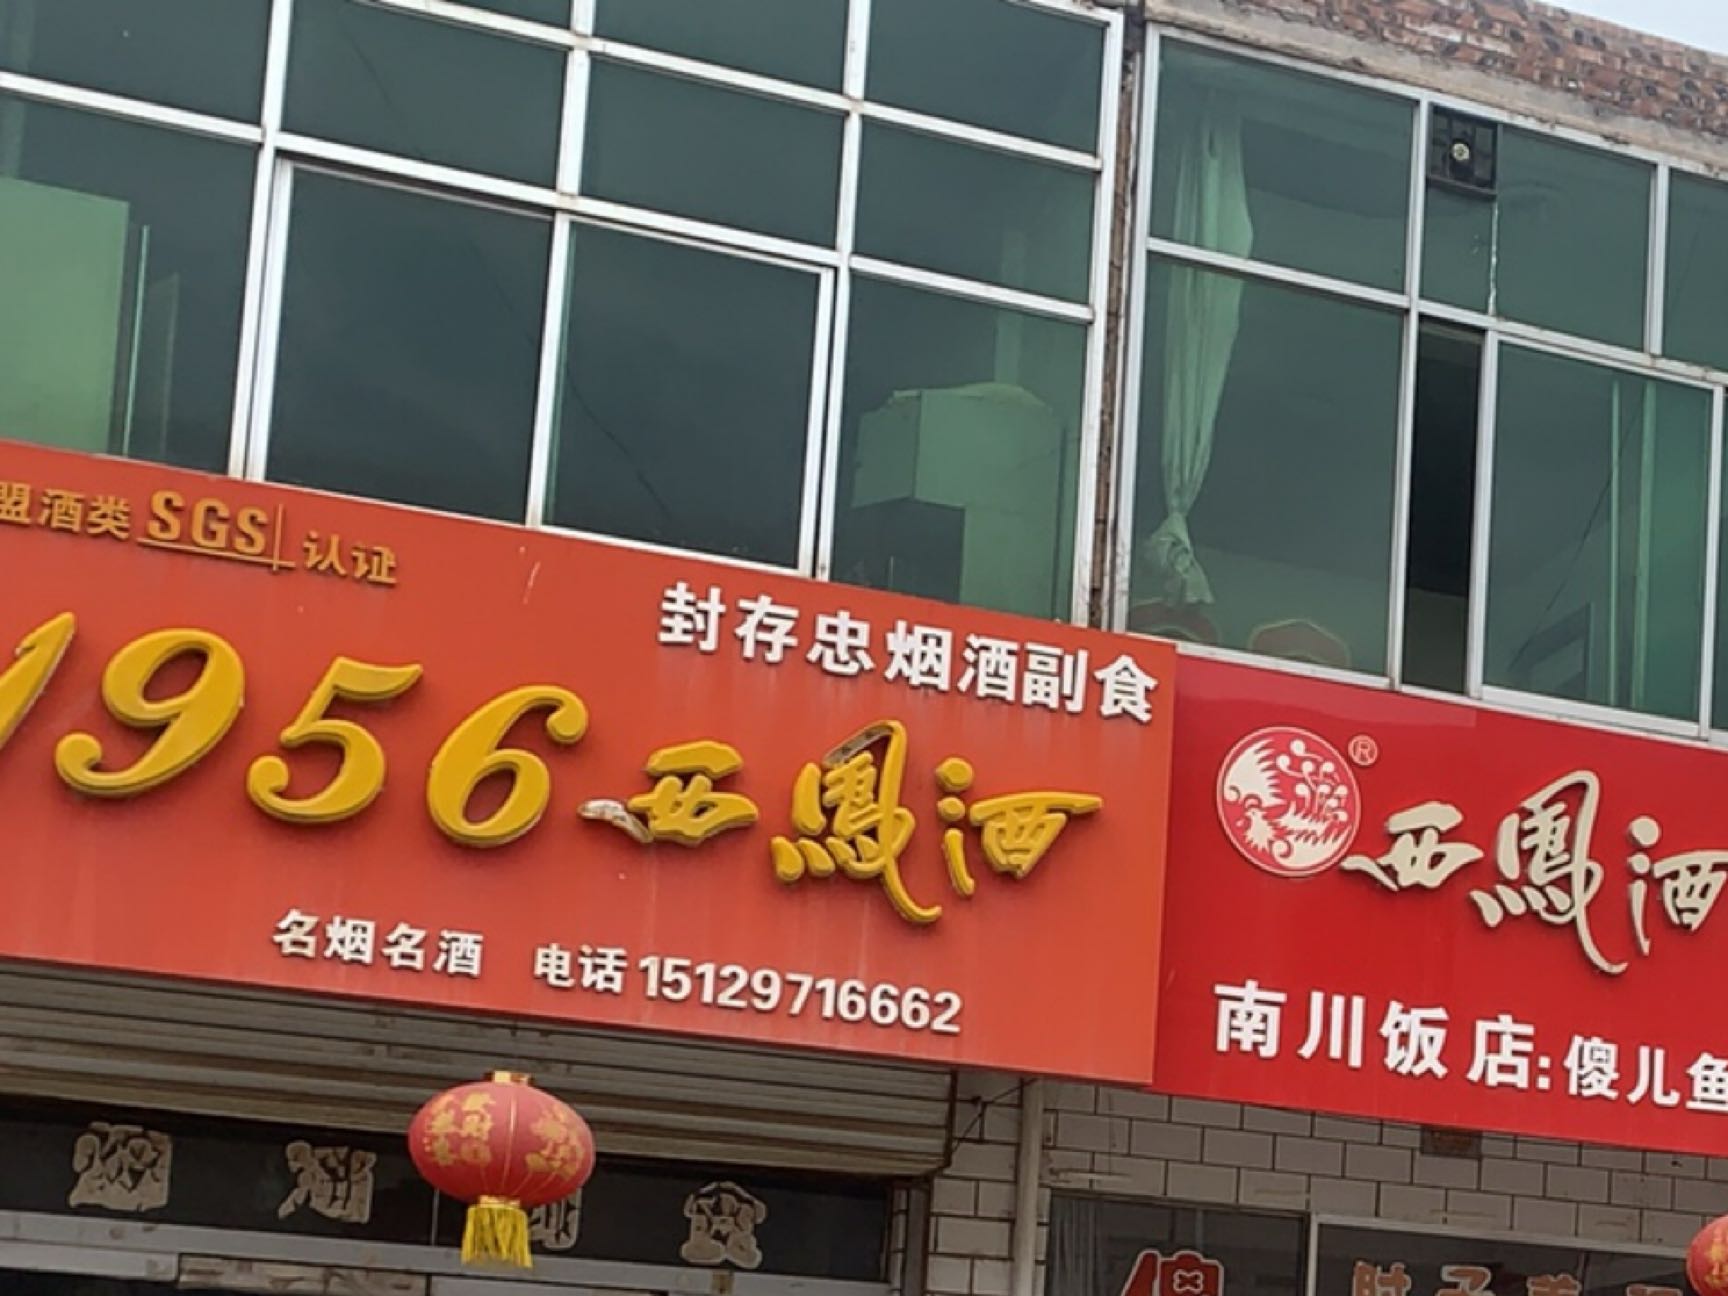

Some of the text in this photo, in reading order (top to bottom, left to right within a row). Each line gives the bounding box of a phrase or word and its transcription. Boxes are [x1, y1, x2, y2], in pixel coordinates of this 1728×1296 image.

[658, 582, 1158, 723] 封存忠烟酒副食
[273, 908, 485, 979] 名烟名酒
